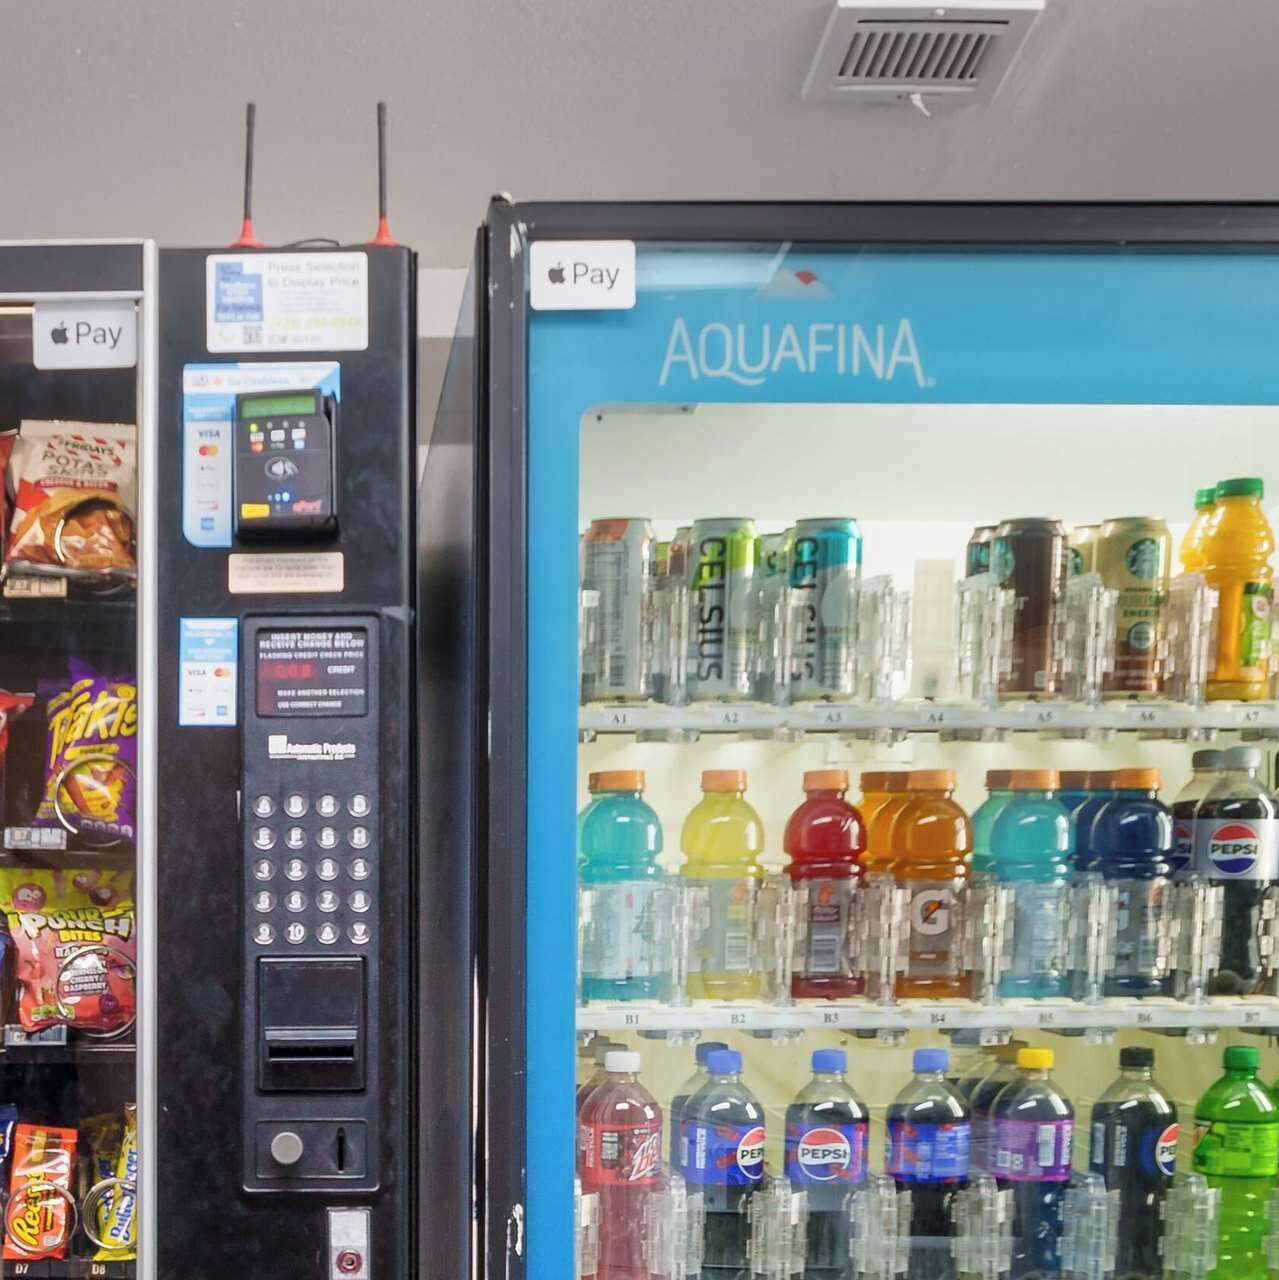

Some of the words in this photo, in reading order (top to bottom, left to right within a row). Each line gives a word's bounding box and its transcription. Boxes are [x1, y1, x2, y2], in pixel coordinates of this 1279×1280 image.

[573, 262, 620, 290] Pay
[75, 320, 122, 348] Pay
[658, 316, 926, 389] AQUAFINA
[696, 537, 727, 681] CELSIUS
[327, 665, 355, 675] CREDIT
[722, 712, 738, 723] A2
[1211, 844, 1259, 856] PEPSI
[19, 911, 133, 943] PUNCH
[58, 930, 102, 943] BITES
[625, 1014, 639, 1025] B1
[731, 1014, 746, 1025] B2
[740, 1148, 765, 1161] PEP
[800, 1147, 848, 1160] PEPSI
[15, 1263, 29, 1275] D7
